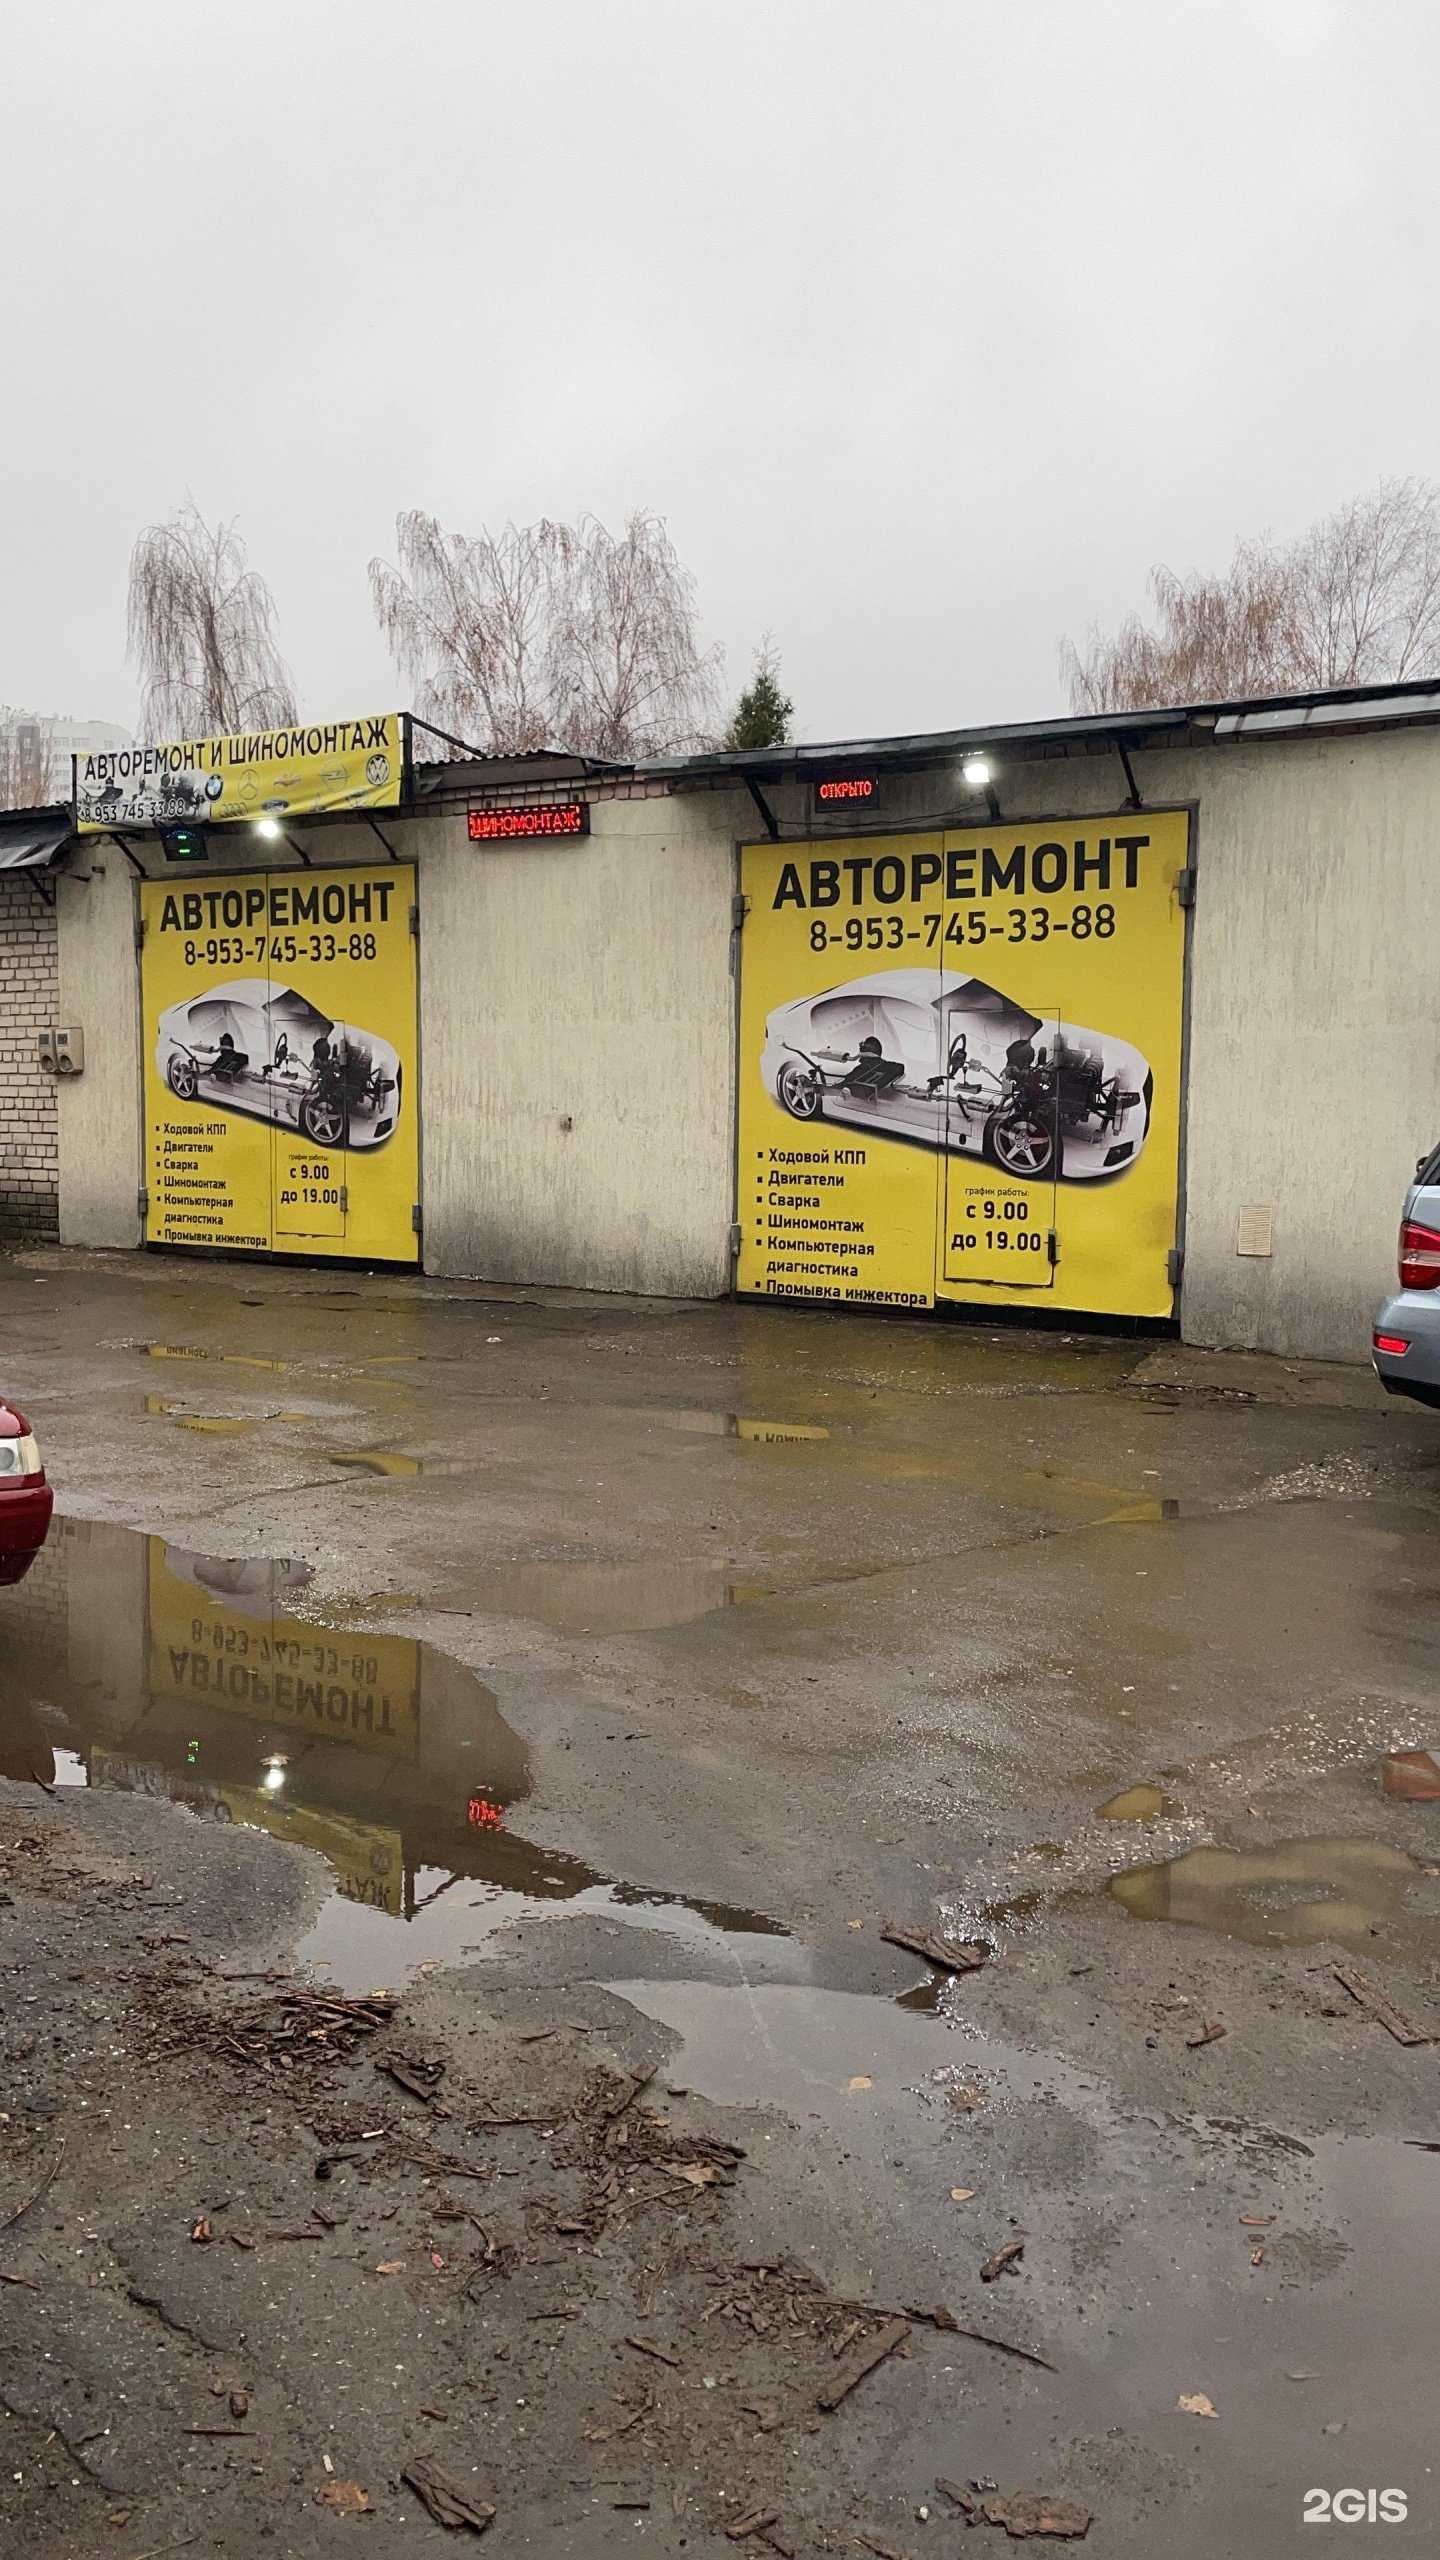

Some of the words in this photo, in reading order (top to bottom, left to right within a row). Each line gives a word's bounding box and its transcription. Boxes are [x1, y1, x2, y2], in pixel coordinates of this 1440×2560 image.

[84, 742, 205, 781] АВТОРЕМОНТ
[211, 740, 222, 767] И
[229, 718, 389, 765] ШИНОМОНТАЖ
[820, 780, 872, 799] ОТКРЫТО
[95, 804, 117, 822] 953
[122, 802, 144, 819] 745
[150, 801, 165, 817] 33
[168, 799, 184, 816] 88
[472, 812, 576, 834] ШИНОМОНТАЖ
[772, 835, 1150, 910] АВТОРЕМОНТ
[160, 881, 395, 932] АВТОРЕМОНТ
[810, 903, 1116, 952] 8-953-745-33-88
[184, 933, 377, 966] 8-953-745-33-88
[164, 1123, 204, 1136] Ходовой
[206, 1124, 226, 1135] КПП
[164, 1141, 213, 1154] Двигатели
[769, 1148, 829, 1165] Ходовой
[834, 1150, 866, 1165] КПП
[164, 1159, 199, 1172] Сварка
[301, 1164, 329, 1180] 9.00
[164, 1176, 227, 1190] Шиномонтаж
[768, 1170, 844, 1187] Двигатели
[164, 1194, 234, 1209] Компьютерная
[281, 1191, 298, 1204] до
[303, 1188, 338, 1204] 19.00
[768, 1192, 820, 1210] Сварка
[965, 1188, 995, 1197] график
[164, 1213, 224, 1225] диагностика
[984, 1201, 1028, 1220] 9.00
[767, 1214, 864, 1232] Шиномонтаж
[164, 1229, 213, 1243] Промывка
[215, 1234, 267, 1248] инжектора
[767, 1236, 875, 1257] Компьютерная
[951, 1234, 976, 1251] до
[985, 1231, 1041, 1251] 19.00
[767, 1261, 858, 1277] диагностика
[766, 1280, 841, 1297] Промывка
[845, 1288, 927, 1307] инжектора
